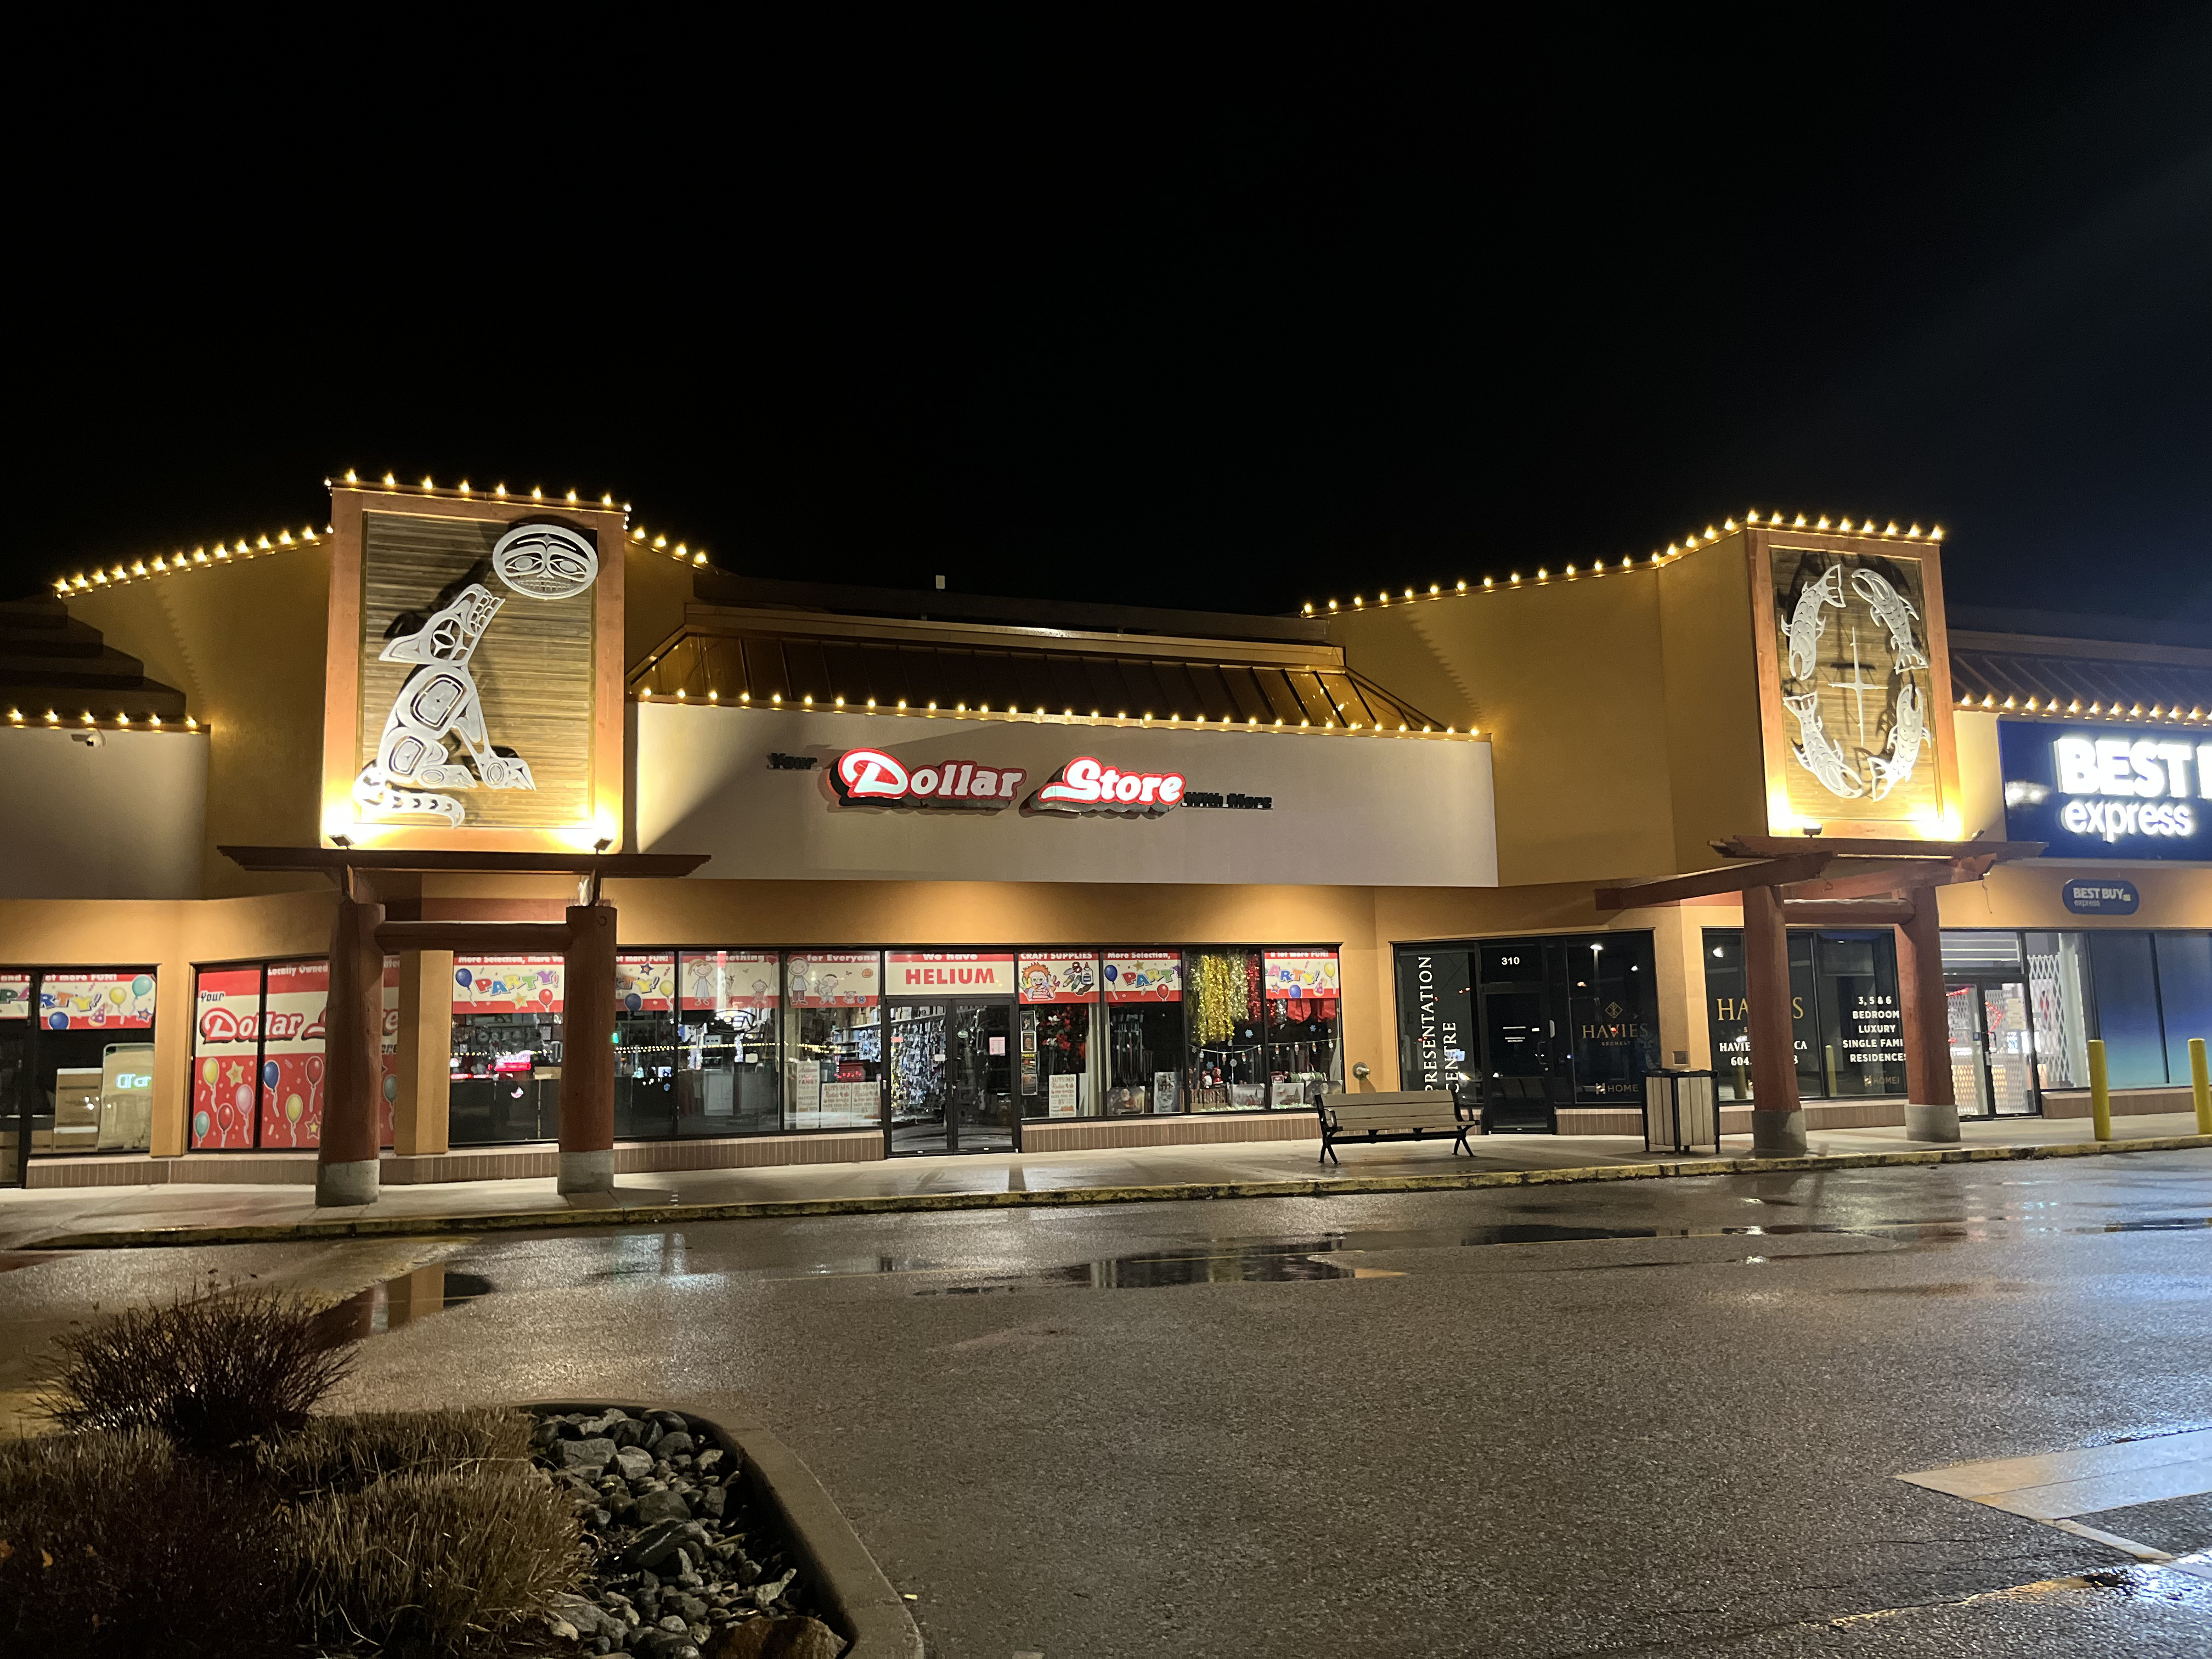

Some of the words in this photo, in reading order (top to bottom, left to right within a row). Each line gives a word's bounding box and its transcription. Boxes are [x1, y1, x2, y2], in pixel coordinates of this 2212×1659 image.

[839, 749, 1024, 799] Dollar
[1040, 758, 1183, 803] Store
[2054, 738, 2192, 798] BEST
[2061, 800, 2192, 843] express
[2073, 888, 2100, 899] BEST
[2102, 888, 2124, 900] BUY
[705, 955, 765, 963] Soething
[827, 953, 877, 962] Everyone
[1501, 956, 1520, 966] 310
[267, 965, 296, 977] Locally
[299, 962, 328, 973] Owned
[905, 968, 995, 985] HELIUM
[1266, 964, 1319, 985] ARTY!
[473, 970, 559, 996] PARTY!
[200, 991, 225, 1003] Your
[1858, 996, 1867, 1006] 3,
[1869, 996, 1875, 1005] 5
[1877, 996, 1884, 1005] &
[1886, 996, 1892, 1005] 6
[1717, 997, 1804, 1021] HAS
[1852, 1011, 1900, 1019] BEDROOM
[203, 1009, 302, 1039] Dollar
[1418, 956, 1438, 1091] PRESENTATION
[1582, 1023, 1648, 1039] HAVIES
[1858, 1025, 1896, 1034] LUXURY
[1842, 1039, 1877, 1048] SINGLE
[1880, 1038, 1904, 1048] FAMI
[1442, 1022, 1460, 1093] CENTRE
